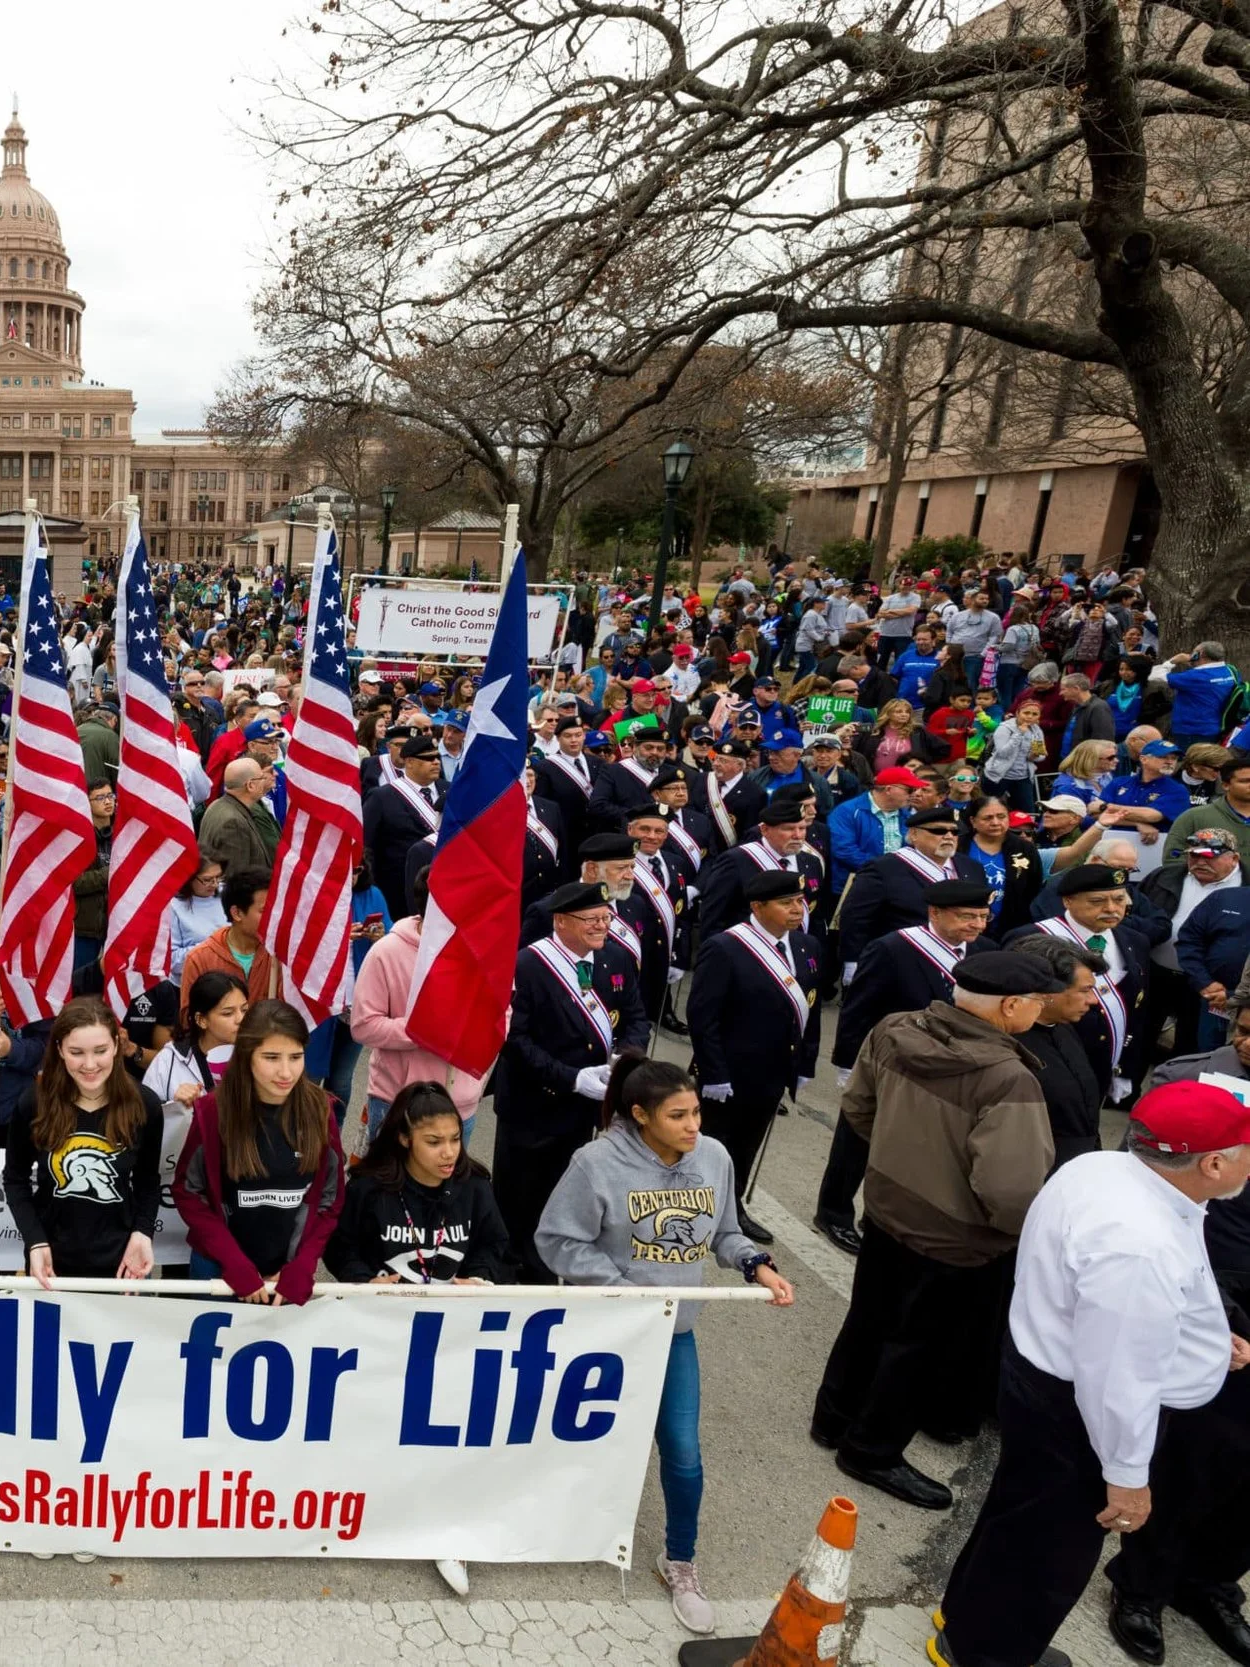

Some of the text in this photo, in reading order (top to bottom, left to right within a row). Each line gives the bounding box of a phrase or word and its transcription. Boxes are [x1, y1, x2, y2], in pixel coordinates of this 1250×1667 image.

[397, 603, 431, 615] Christ
[434, 605, 451, 616] the
[454, 606, 485, 618] Good
[411, 618, 456, 629] Catholic
[432, 634, 488, 645] Spring, Texas
[811, 697, 853, 713] LOVE LIFE
[242, 1193, 302, 1203] UNBORN LIVES
[627, 1186, 715, 1224] CENTURION
[380, 1224, 426, 1245] JOHN
[433, 1224, 469, 1246] PAUL
[179, 1311, 358, 1443] for
[398, 1308, 625, 1448] Life
